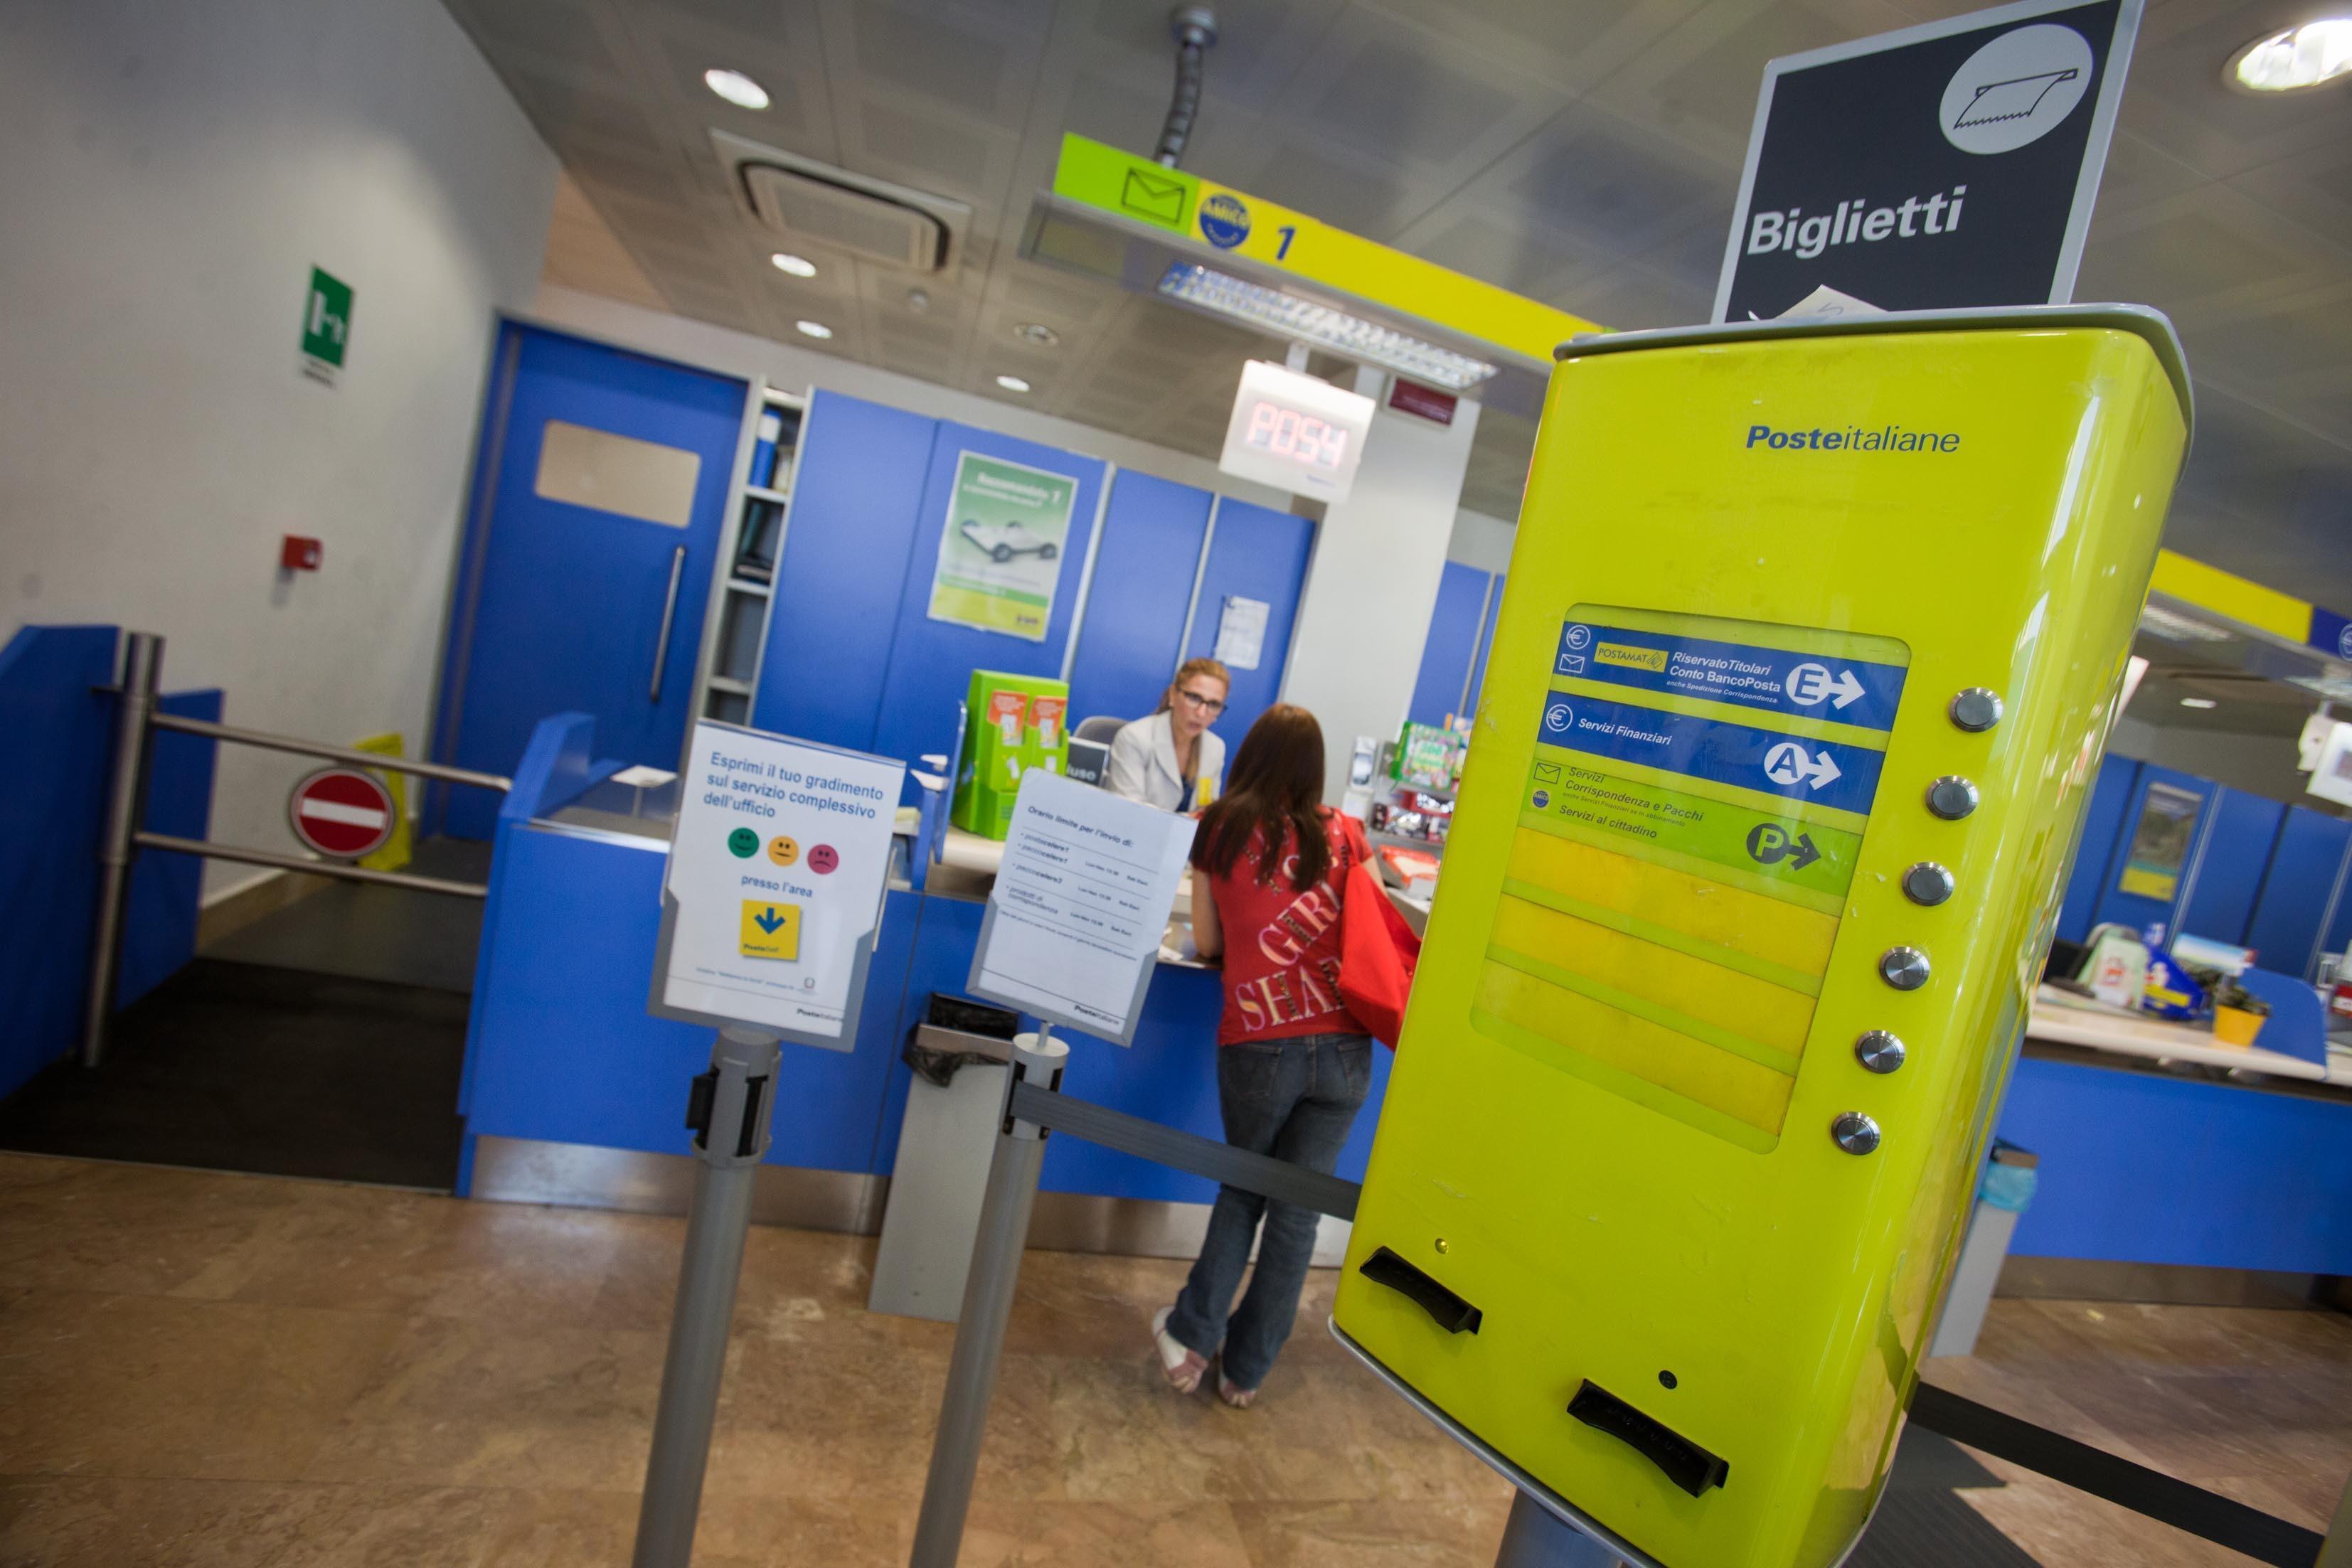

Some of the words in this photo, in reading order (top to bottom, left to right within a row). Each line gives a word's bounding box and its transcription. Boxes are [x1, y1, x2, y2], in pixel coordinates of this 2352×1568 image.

[1747, 184, 1967, 259] Biglietti
[1277, 225, 1296, 260] 1
[1746, 425, 1960, 453] Posteitaliane
[1598, 648, 1649, 663] POSTAMAT
[1672, 651, 1728, 669] Riservato
[1728, 659, 1772, 676] Titolari
[1670, 666, 1704, 680] Conto
[1707, 671, 1781, 693] BancoPosta
[1686, 683, 1722, 694] Spedizione
[1723, 689, 1778, 704] Corrispondenza
[1794, 668, 1825, 700] E
[1578, 718, 1615, 735] Servizi
[1615, 725, 1673, 745] Finanziari
[711, 751, 765, 774] Esprimi
[767, 766, 776, 778] il
[779, 768, 802, 784] tuo
[805, 774, 883, 801] gradimento
[1569, 767, 1605, 783] Servizi
[1769, 747, 1799, 779] A
[703, 792, 775, 818] dell'ufficio
[707, 773, 729, 787] sul
[731, 779, 786, 800] servizio
[789, 791, 876, 819] complessivo
[1565, 779, 1651, 809] Corrispondenza
[1663, 803, 1705, 821] Pacchi
[1581, 796, 1600, 805] Servizi
[1601, 801, 1629, 813] Finanziari
[1646, 812, 1686, 826] abbinamento
[1028, 806, 1053, 821] Orario
[1055, 815, 1077, 828] limite
[1079, 825, 1095, 836] per
[1559, 805, 1595, 821] Servizi
[1596, 816, 1607, 825] al
[1609, 819, 1657, 838] cittadino
[1755, 827, 1784, 857] P
[741, 875, 779, 890] presso
[782, 882, 812, 898] l'area
